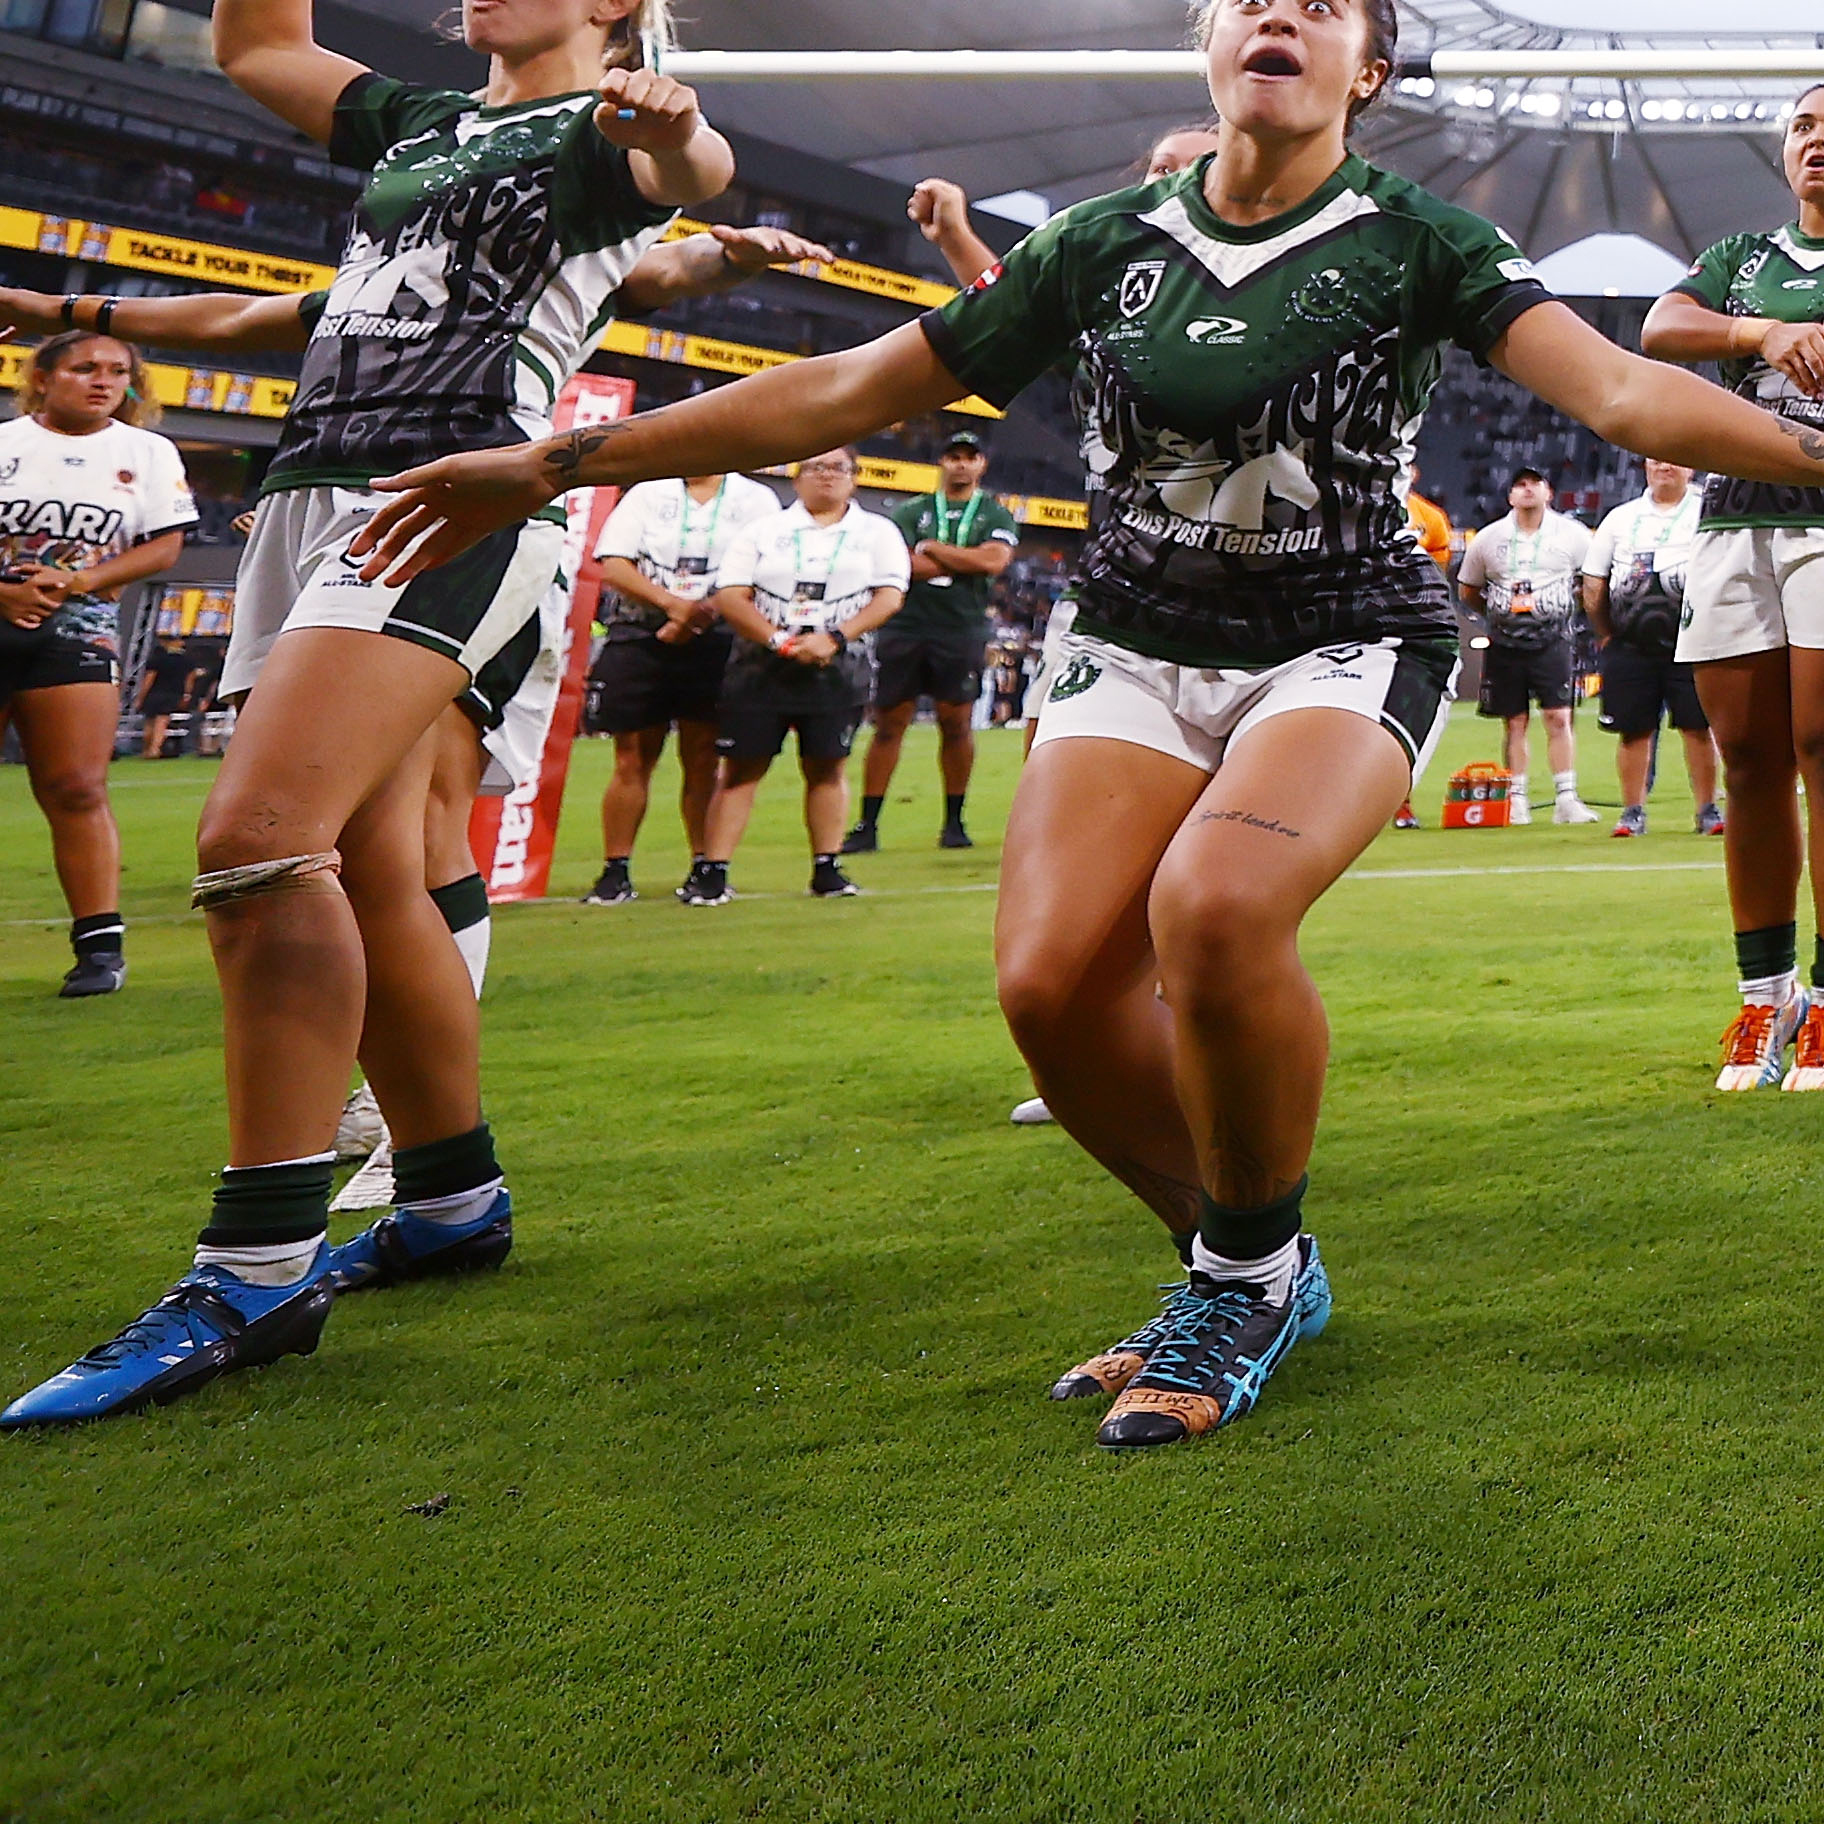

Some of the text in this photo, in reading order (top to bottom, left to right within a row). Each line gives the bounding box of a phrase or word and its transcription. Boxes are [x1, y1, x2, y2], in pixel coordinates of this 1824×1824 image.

[1206, 334, 1246, 345] CLASSIC
[1163, 514, 1212, 550] Post
[1207, 526, 1322, 556] Tension
[1464, 805, 1486, 825] G
